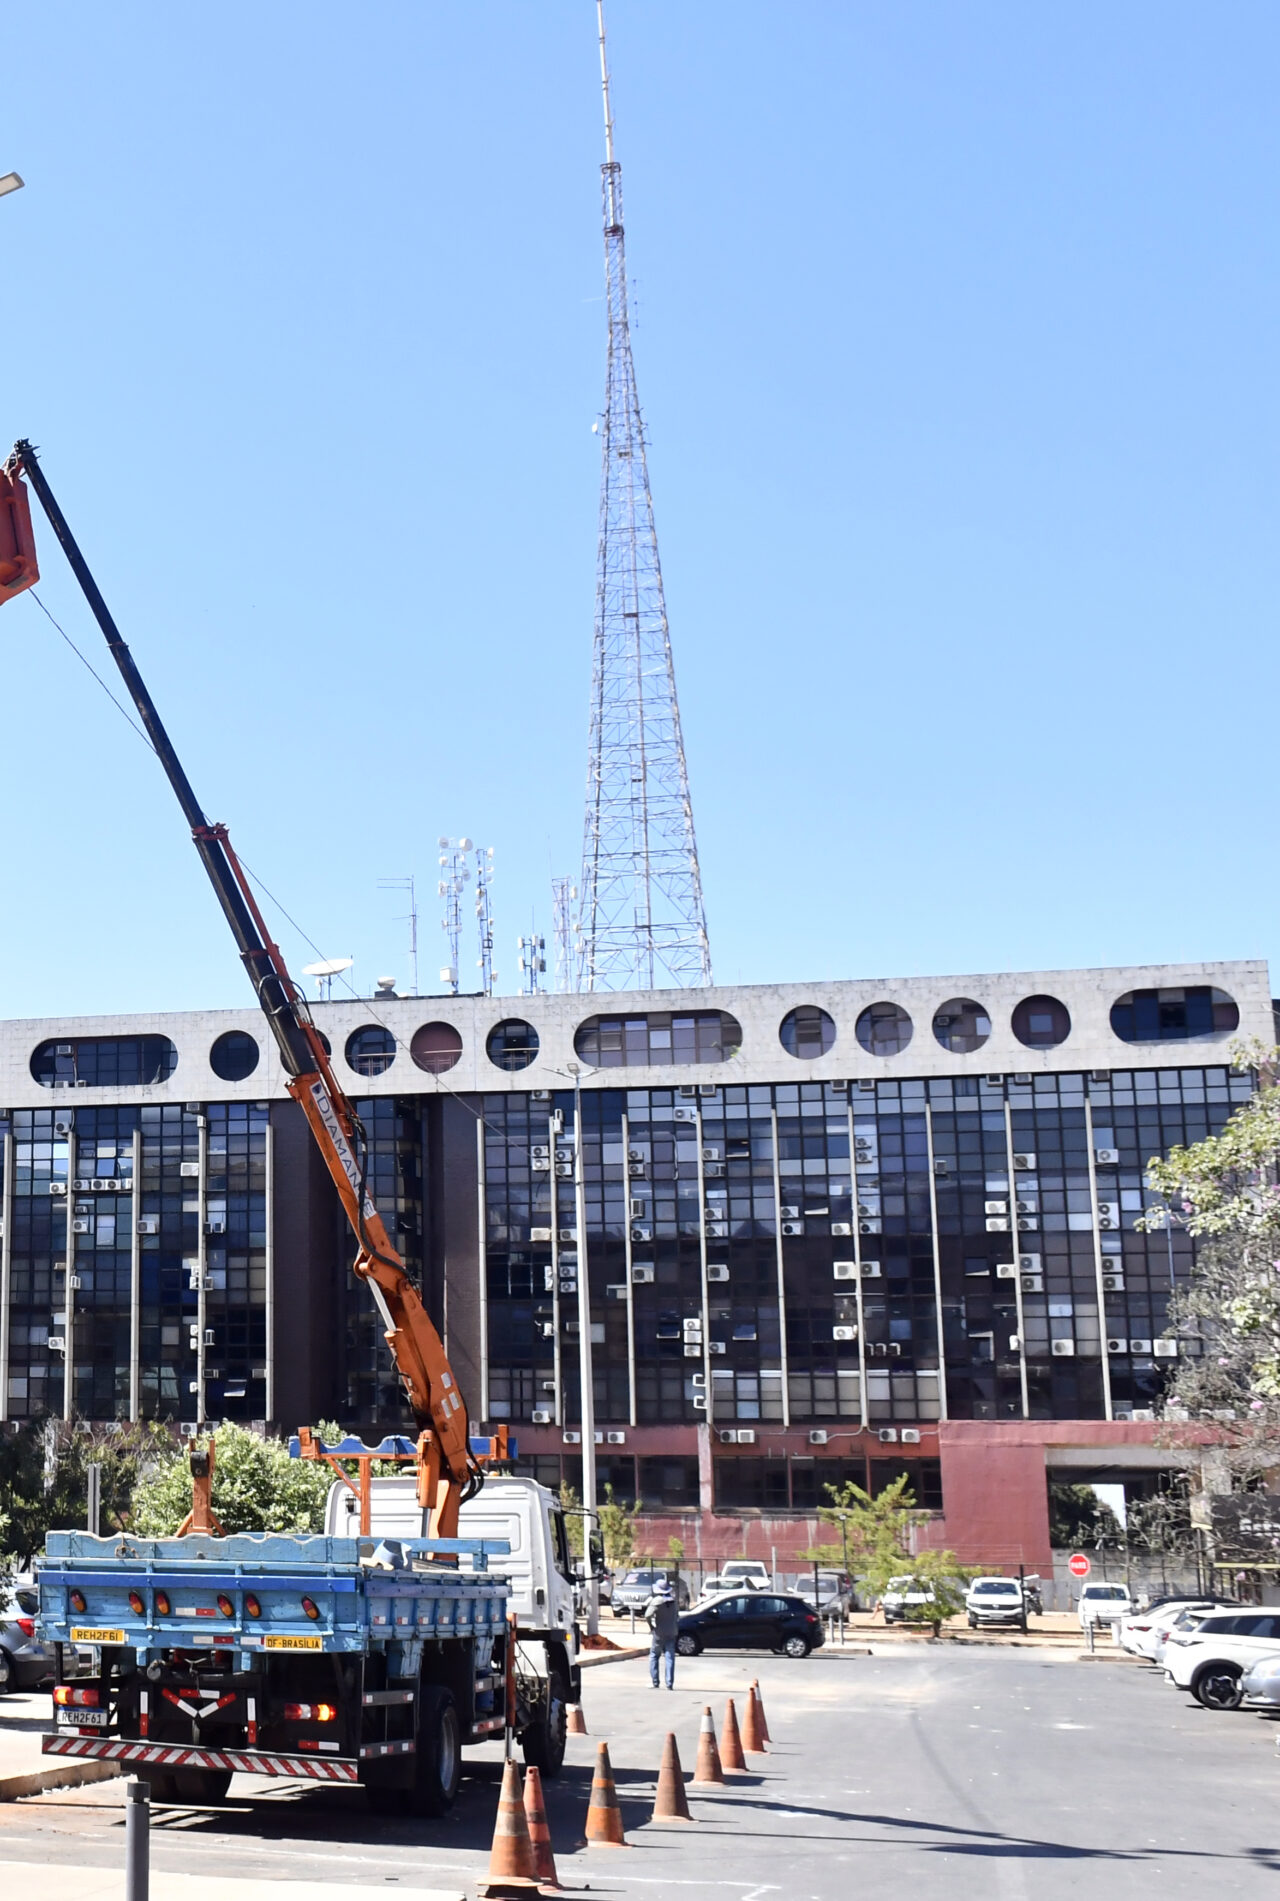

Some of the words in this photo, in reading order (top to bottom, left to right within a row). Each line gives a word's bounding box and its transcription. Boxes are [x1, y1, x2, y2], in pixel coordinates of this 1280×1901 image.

[317, 1096, 374, 1217] DIAMANE
[76, 1630, 119, 1641] REH2F61
[62, 1712, 102, 1724] REH2F61
